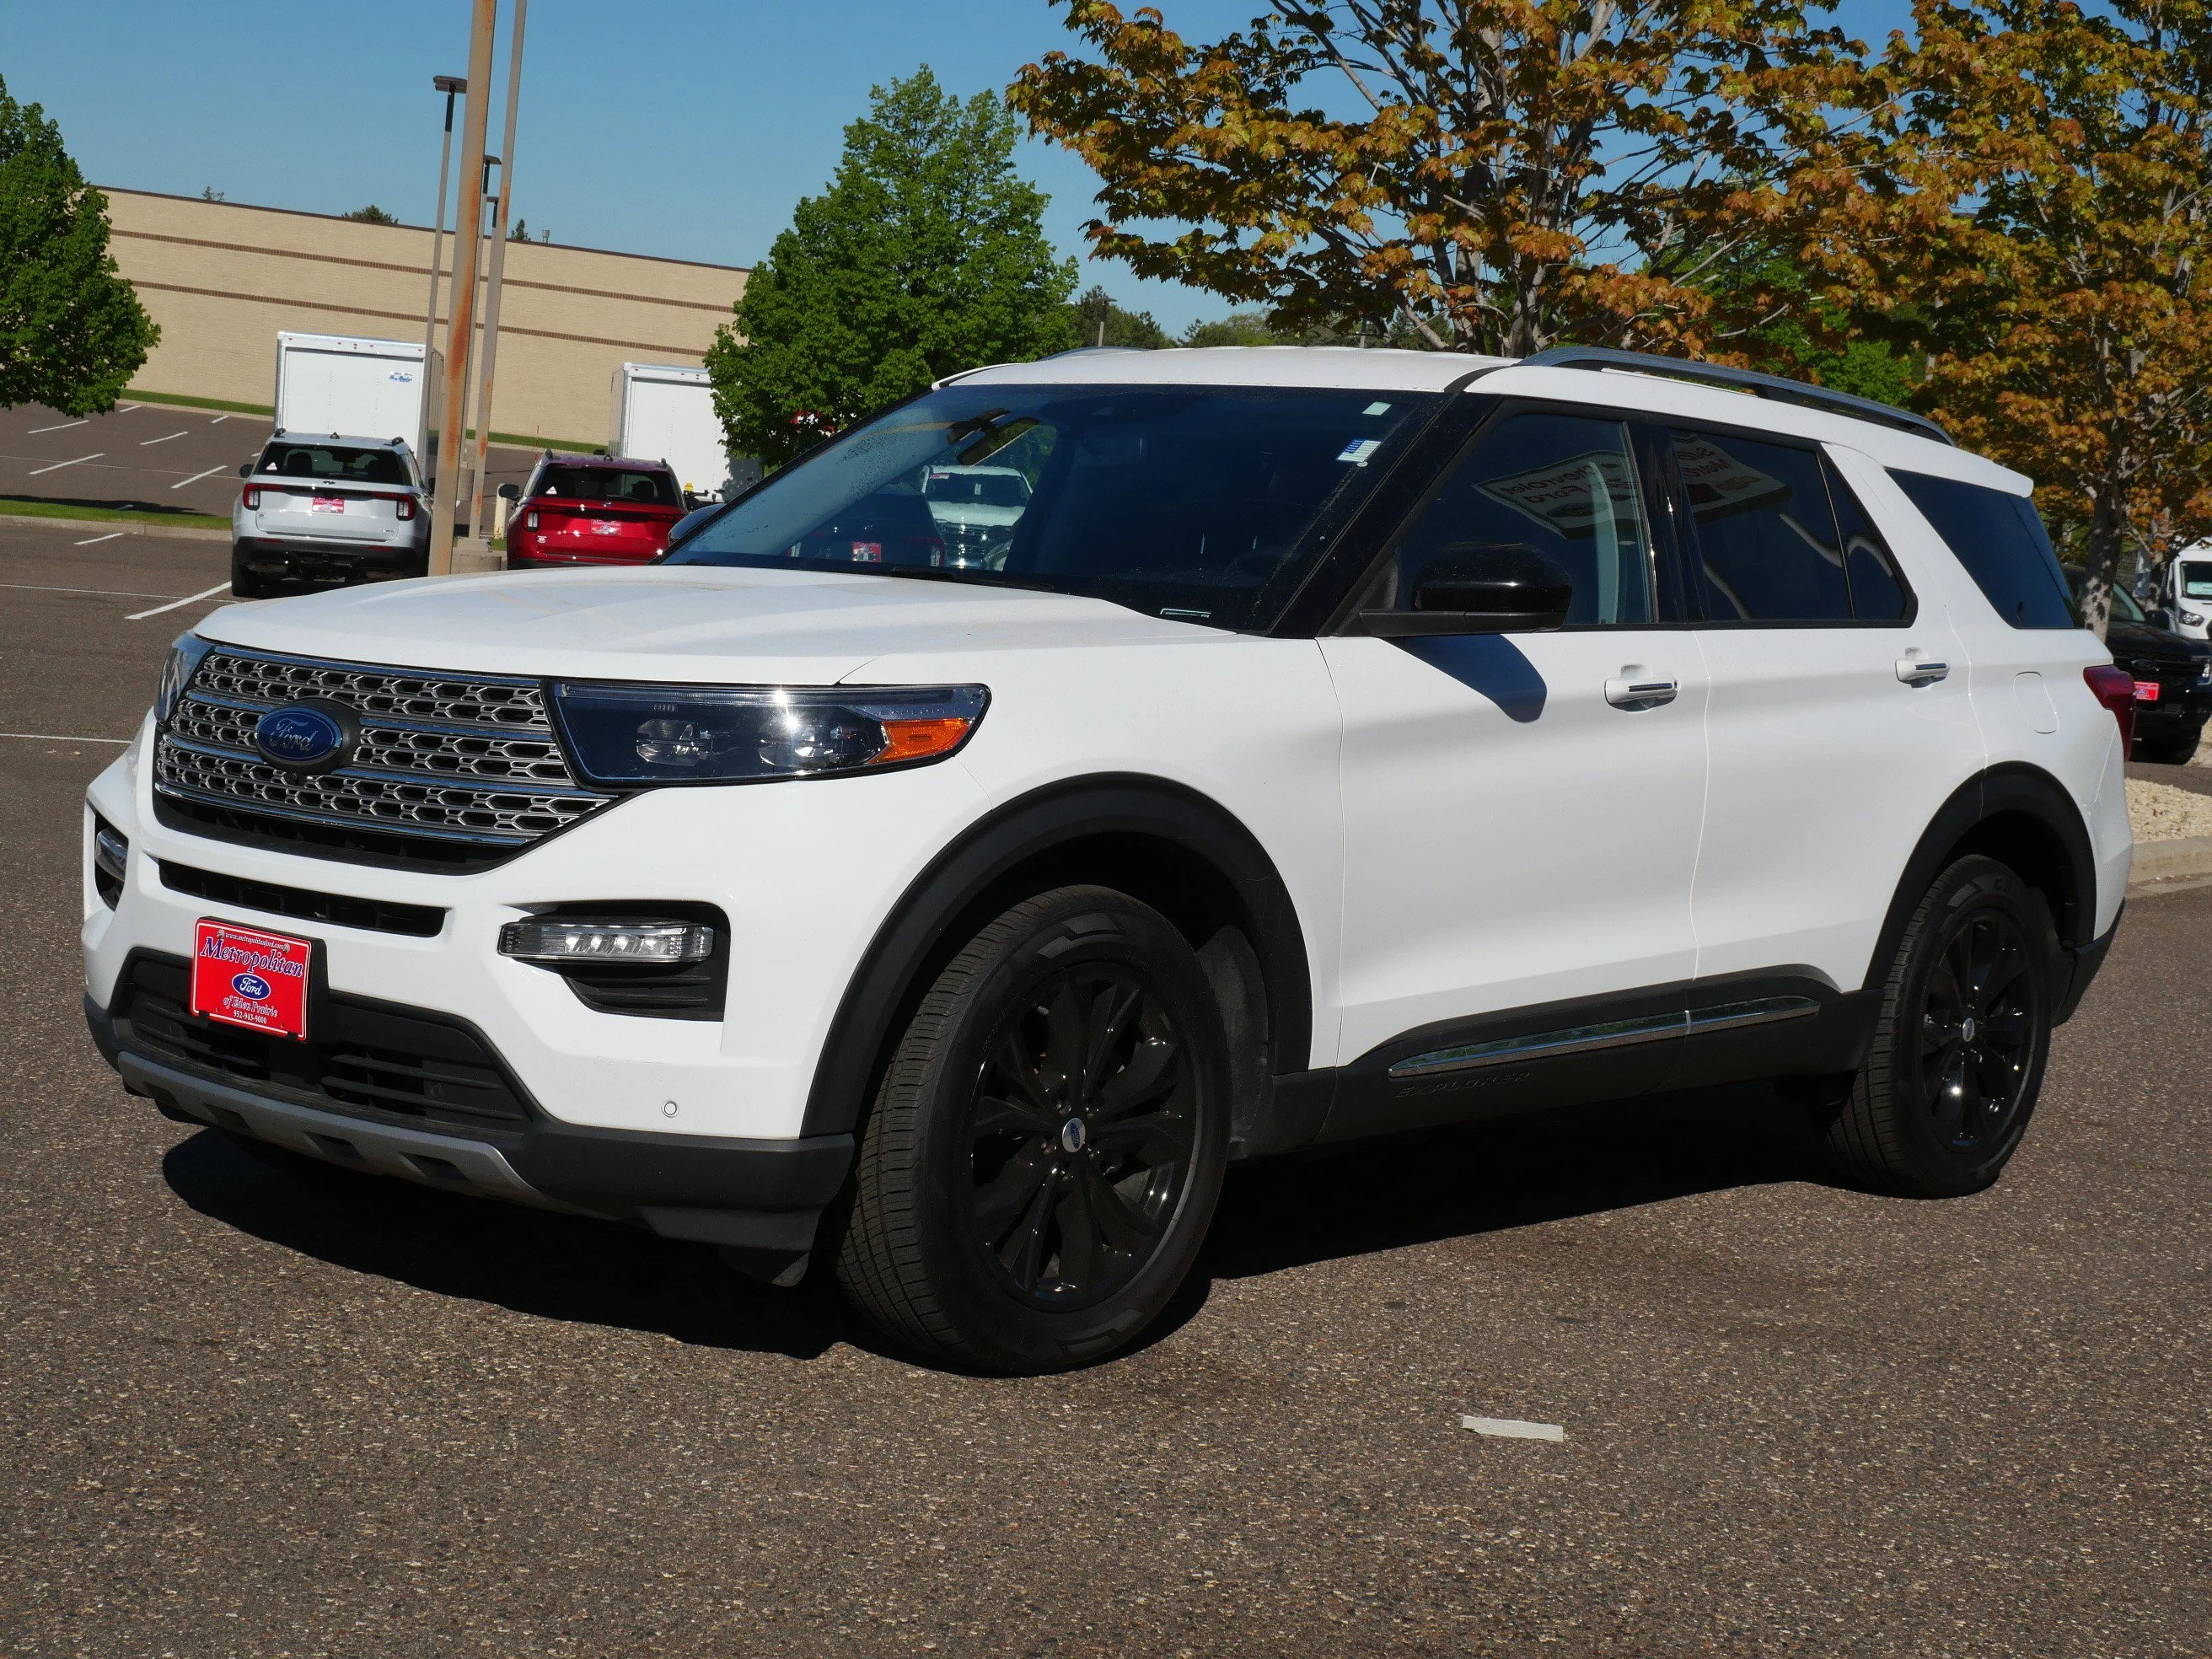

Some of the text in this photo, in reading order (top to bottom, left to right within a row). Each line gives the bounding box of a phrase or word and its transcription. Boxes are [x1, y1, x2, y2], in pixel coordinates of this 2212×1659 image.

[270, 717, 319, 752] Ford
[200, 937, 303, 978] Metropolitan
[239, 977, 262, 996] Ford
[223, 995, 278, 1018] of Eden Prairie
